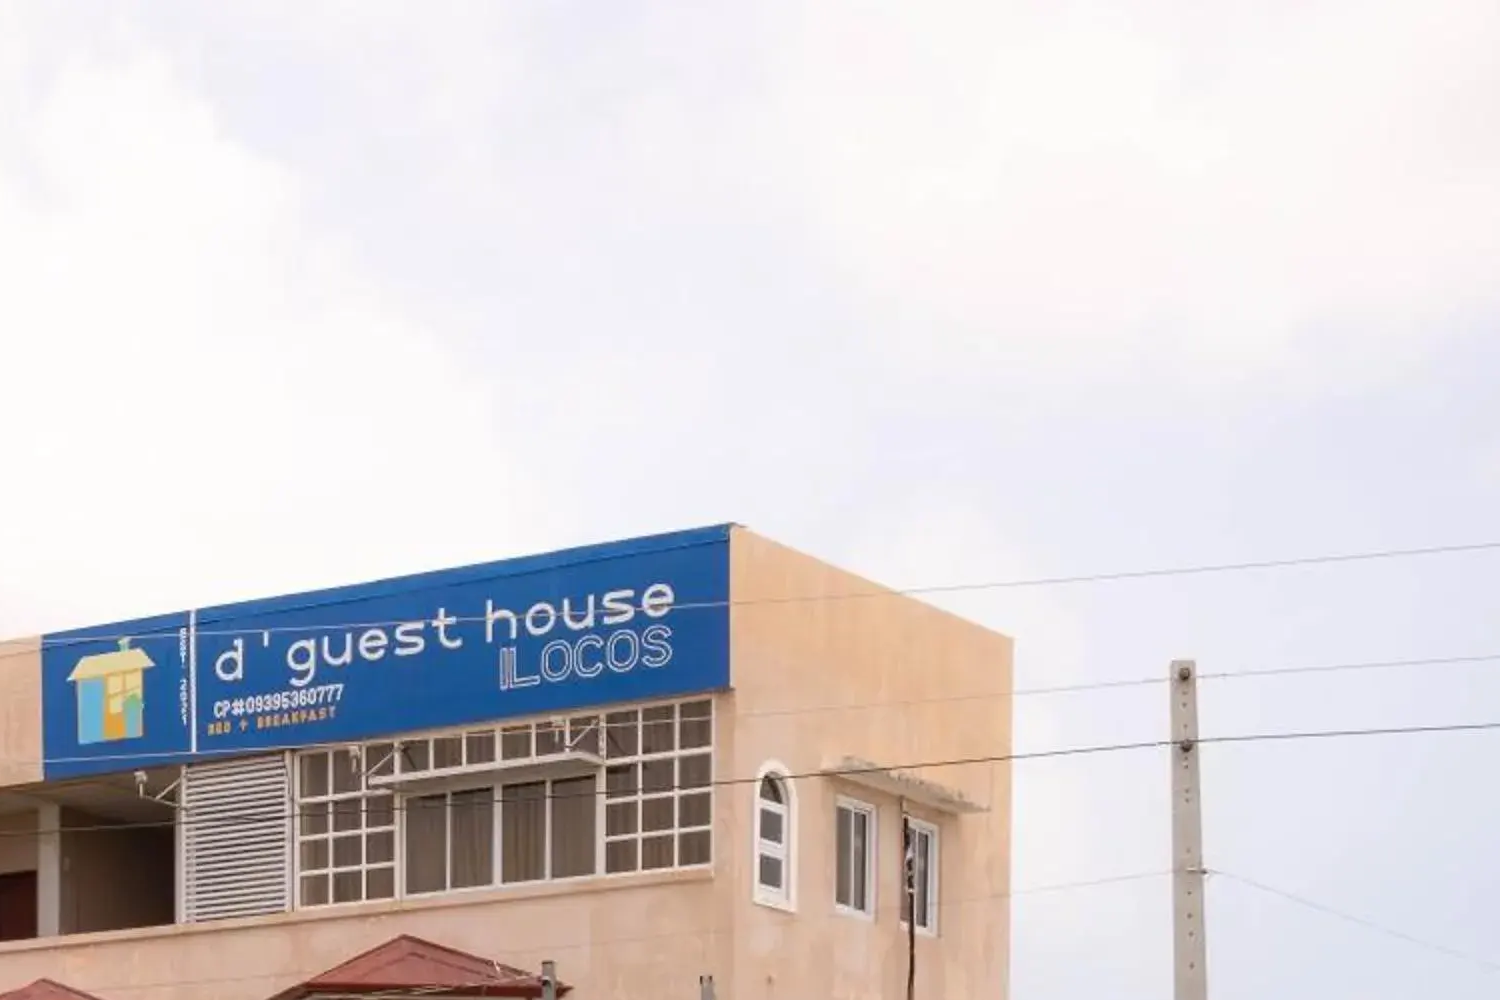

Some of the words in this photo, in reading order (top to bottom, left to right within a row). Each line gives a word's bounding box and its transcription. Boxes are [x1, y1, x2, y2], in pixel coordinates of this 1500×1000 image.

[485, 583, 674, 643] house
[500, 624, 672, 691] ILOCOS
[257, 706, 336, 729] BREAKFAST
